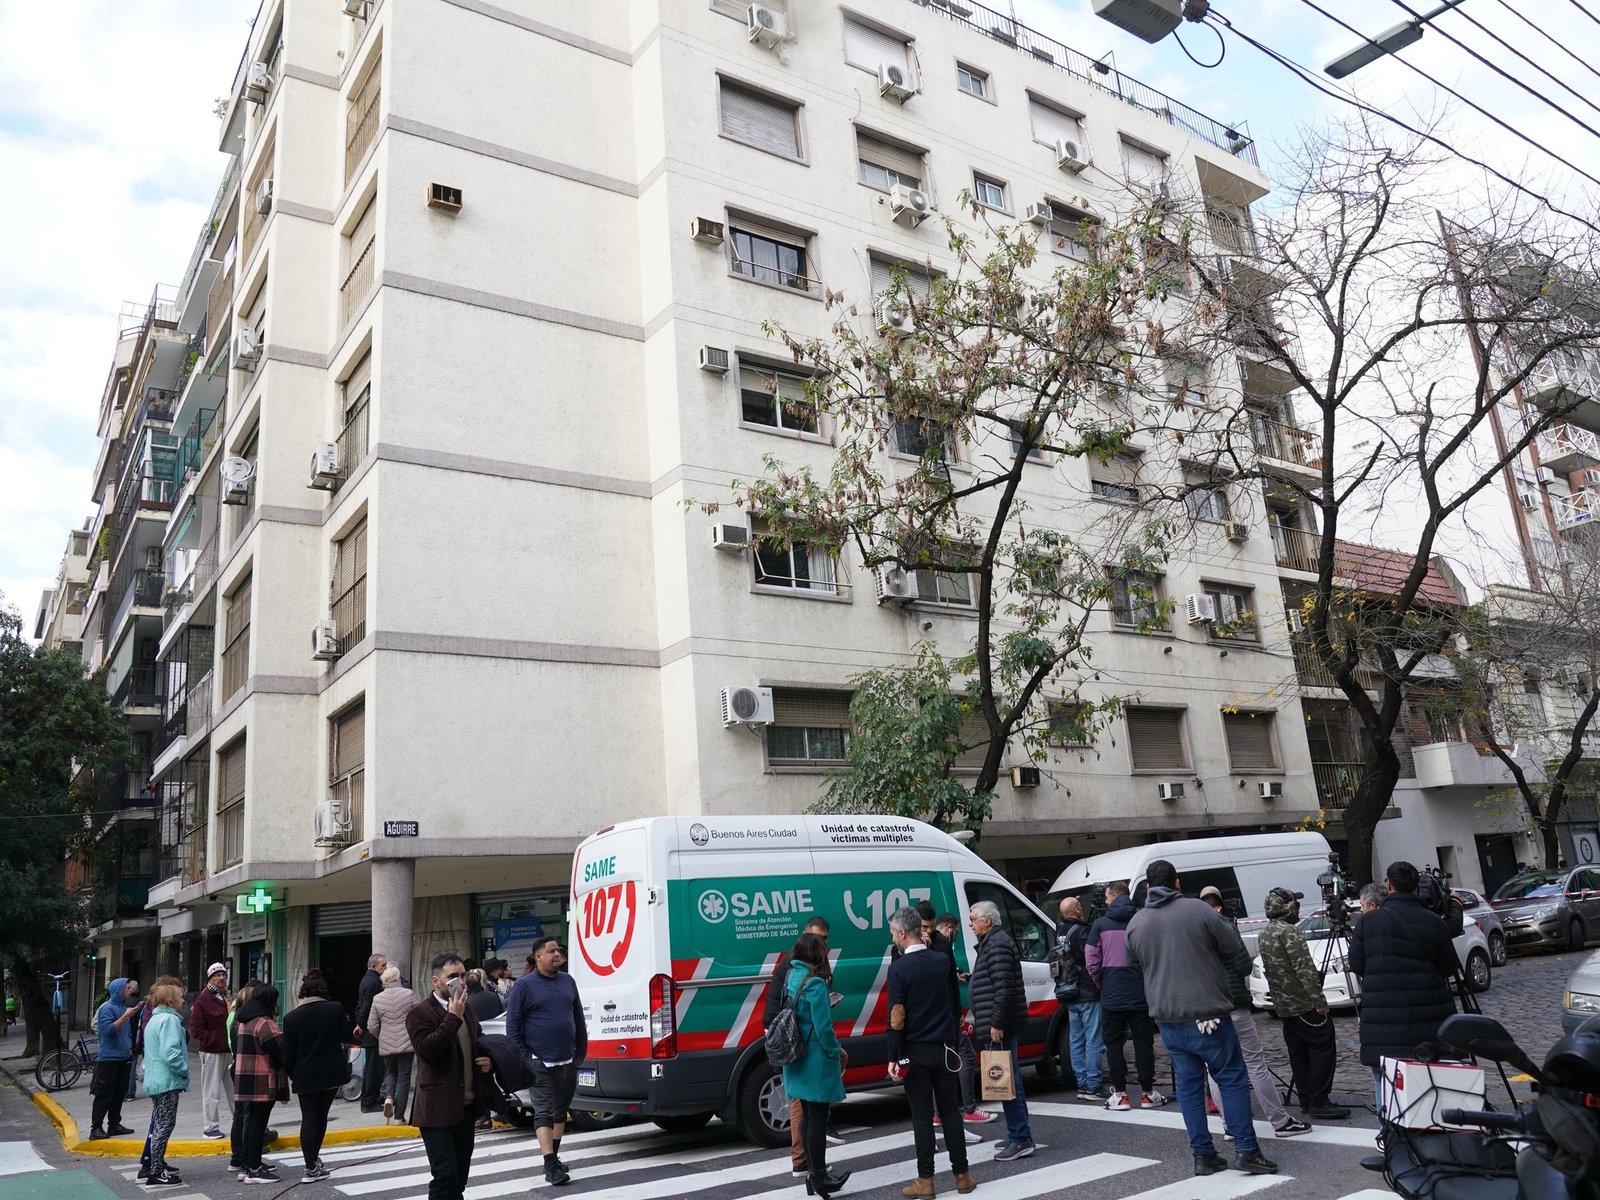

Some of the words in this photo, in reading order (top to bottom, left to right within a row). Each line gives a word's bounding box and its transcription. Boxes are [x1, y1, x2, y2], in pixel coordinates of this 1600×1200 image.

[386, 823, 416, 835] AGUIRRE
[711, 829, 745, 839] Buenos
[746, 828, 768, 838] Aires
[768, 828, 797, 838] Ciudad
[821, 824, 855, 833] Unidad
[856, 824, 868, 832] de
[870, 823, 915, 832] catastrofe
[831, 834, 871, 843] victimas
[873, 833, 914, 844] multiples
[585, 856, 616, 882] SAME
[732, 889, 814, 917] SAME
[584, 883, 623, 939] 107
[765, 922, 798, 930] Emergencia
[736, 931, 770, 940] MINISTERIO
[779, 929, 799, 937] SALUD
[600, 1014, 615, 1023] Unidad
[621, 1012, 649, 1021] catastrofe
[620, 1024, 644, 1035] multiples
